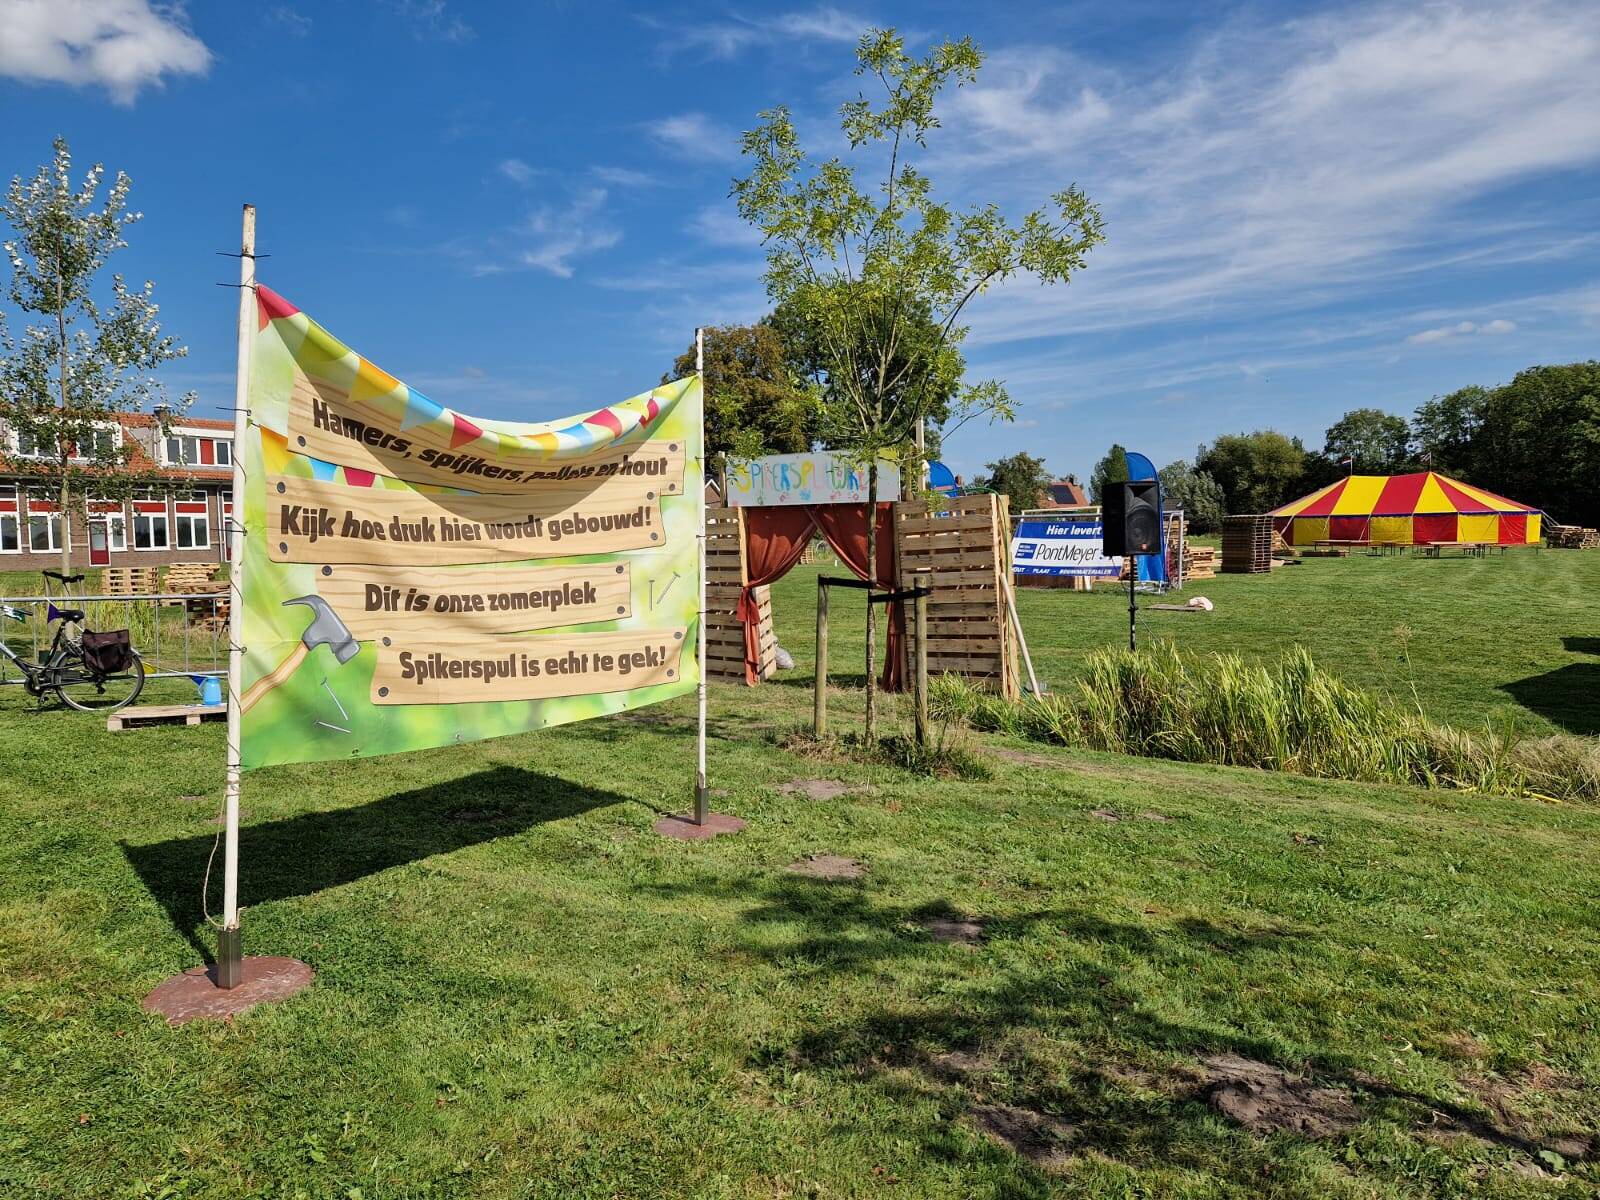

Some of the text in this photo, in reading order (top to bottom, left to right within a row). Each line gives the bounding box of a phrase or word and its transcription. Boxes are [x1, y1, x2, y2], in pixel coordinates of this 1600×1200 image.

[312, 398, 413, 458] Hamers,
[418, 449, 520, 482] spijkers,
[595, 463, 621, 477] en
[619, 455, 668, 476] hout
[281, 505, 651, 542] Kijk hoe druk hier wordt gebouwd!
[1046, 525, 1102, 535] Hier levert
[1036, 544, 1098, 565] PontMeyer
[365, 582, 596, 613] Dit is onze zomerplek
[400, 645, 666, 684] Spikerspul is echt te gek!
